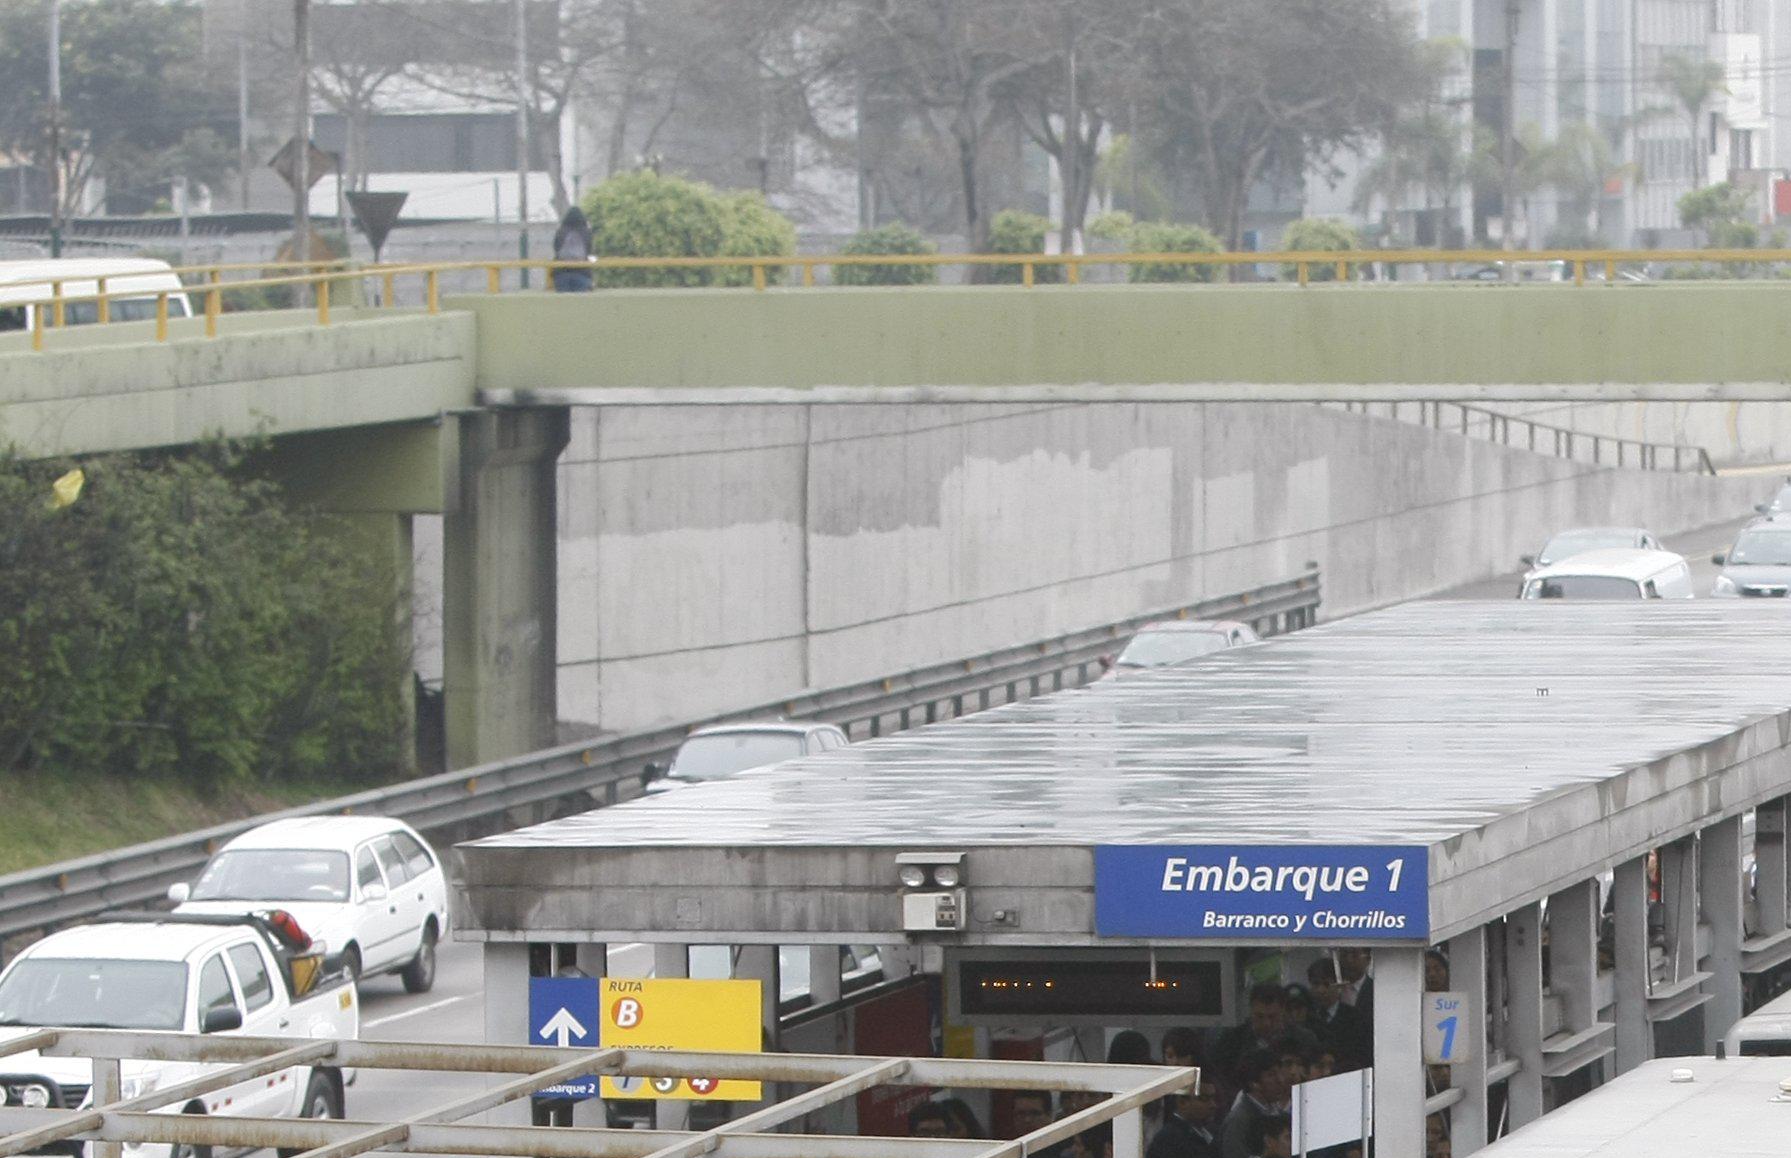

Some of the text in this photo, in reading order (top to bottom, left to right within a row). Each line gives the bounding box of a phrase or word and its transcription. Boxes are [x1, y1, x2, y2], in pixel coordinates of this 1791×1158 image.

[1161, 856, 1404, 901] Embarque 1
[1203, 911, 1406, 932] Barranco y Chorrillos
[609, 981, 643, 992] RUTA
[617, 999, 639, 1027] B
[1435, 999, 1459, 1010] Sur
[1436, 1016, 1457, 1059] 1
[588, 1083, 596, 1093] 2
